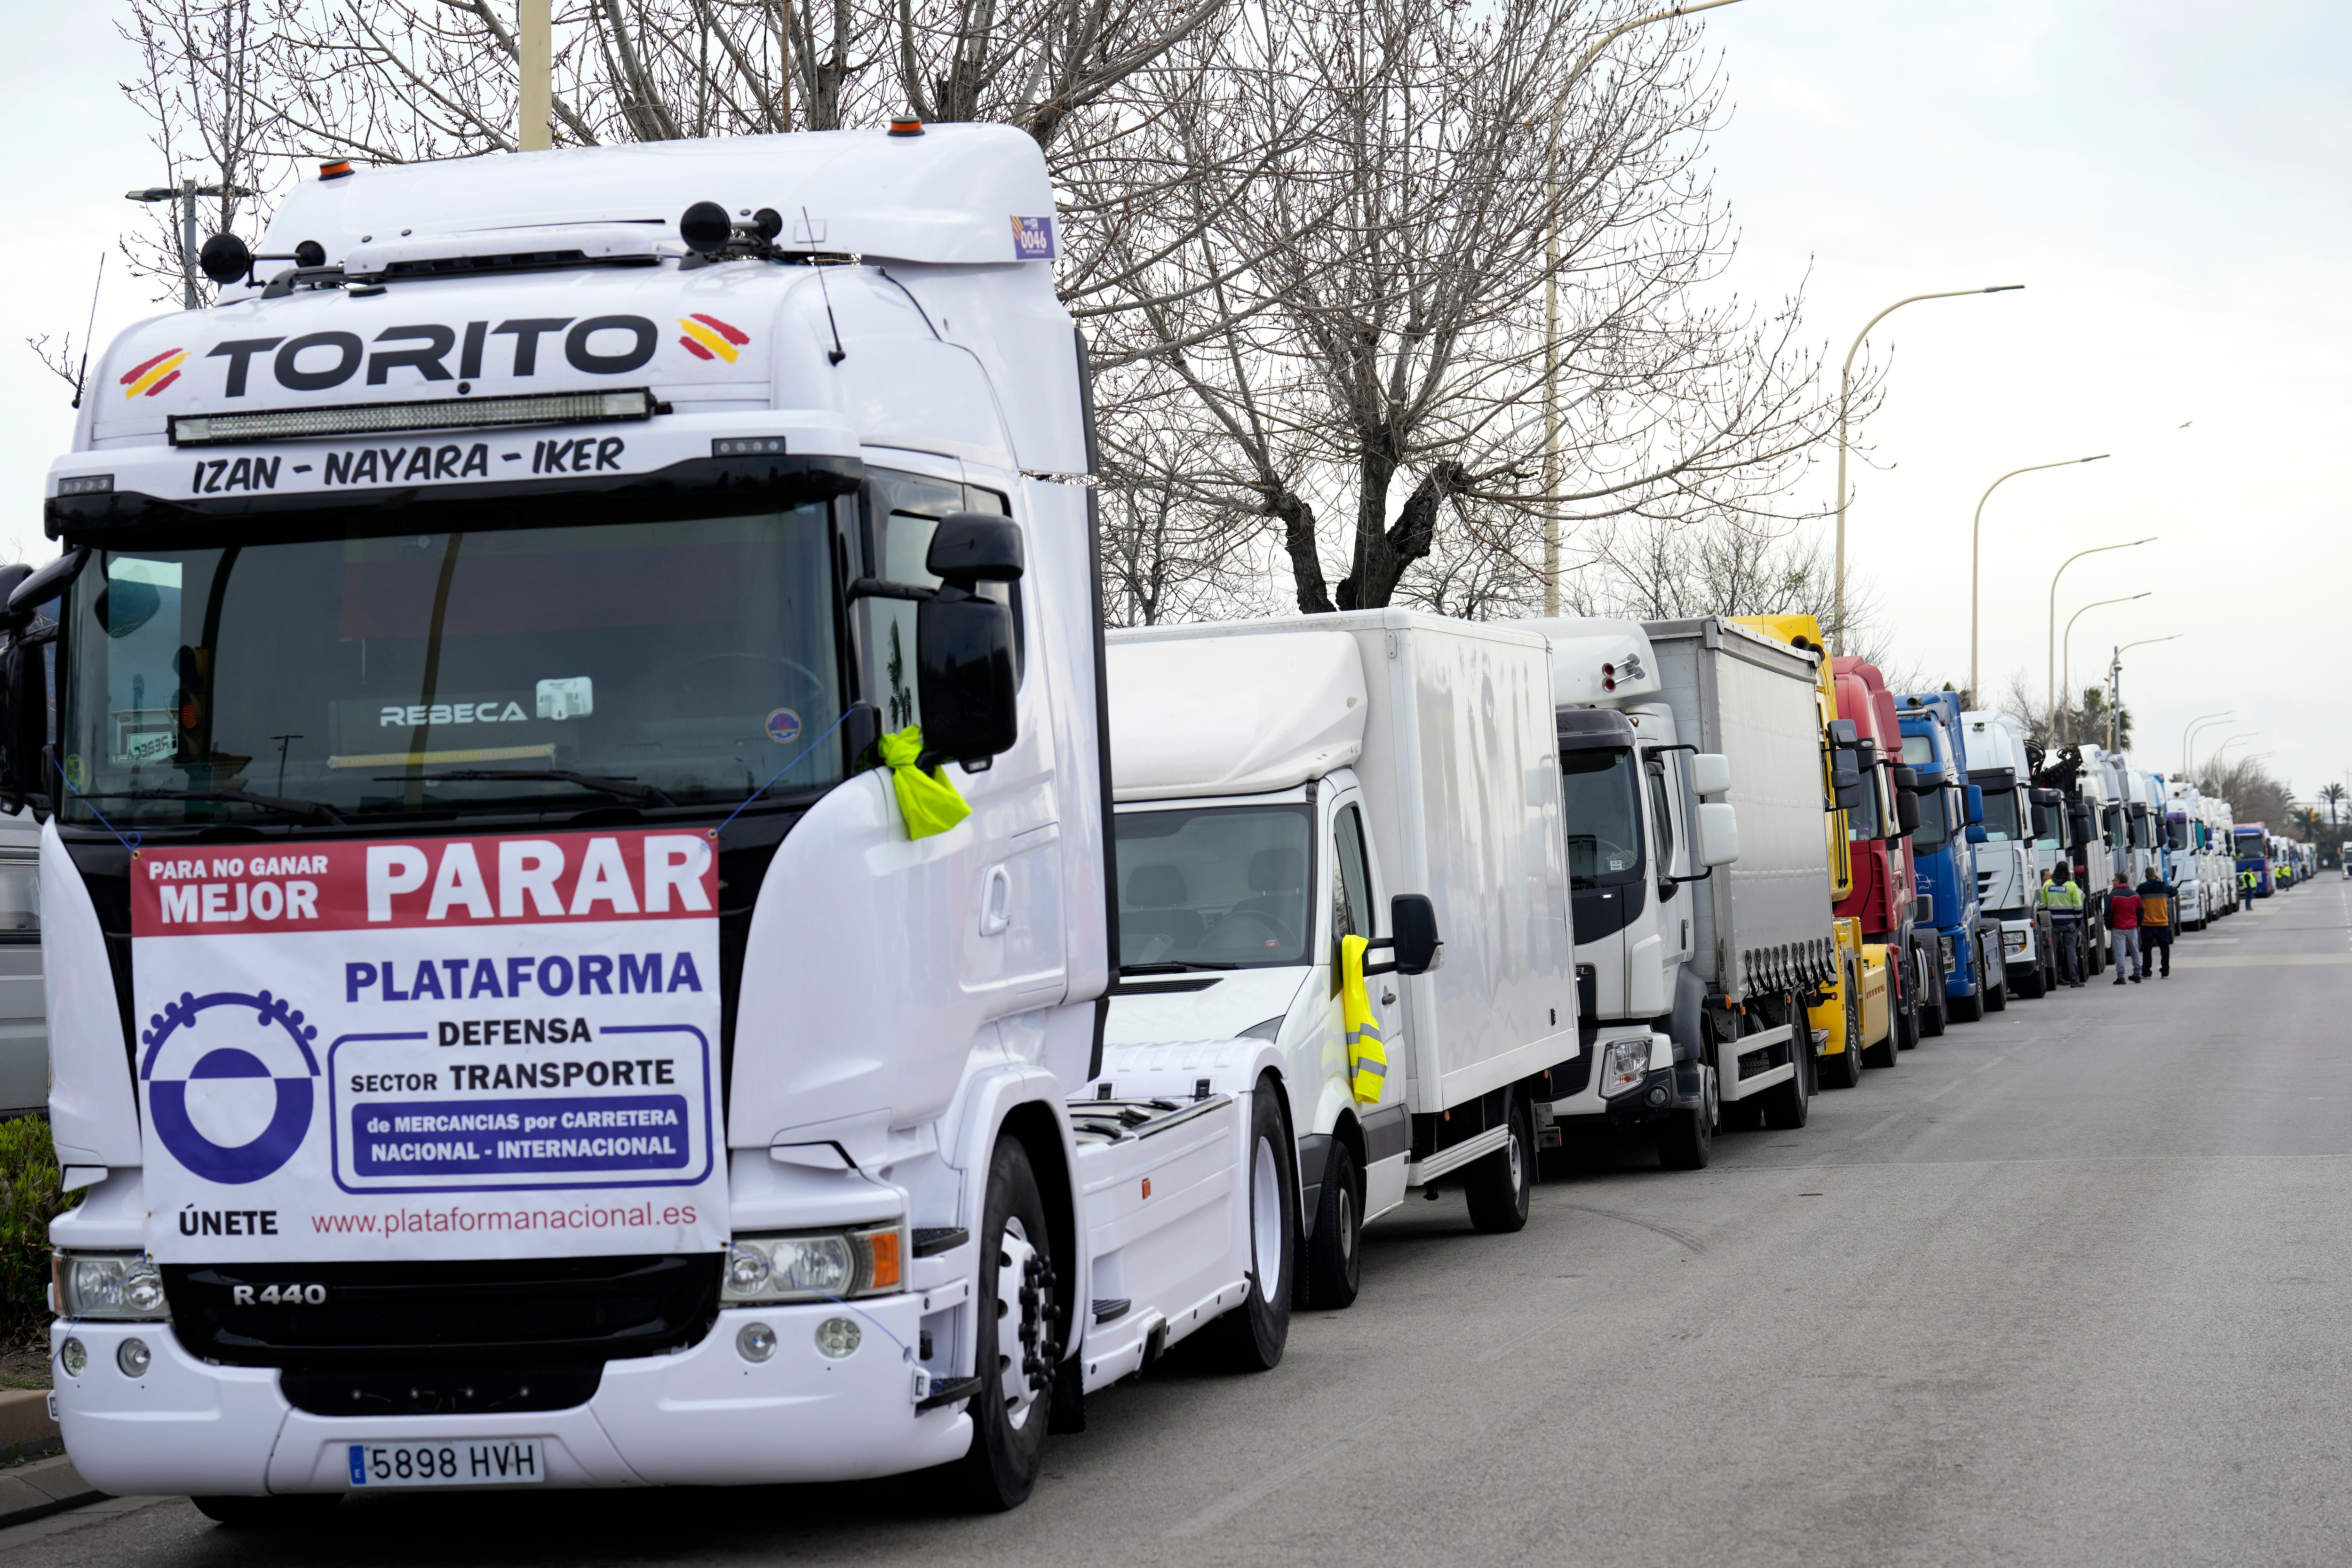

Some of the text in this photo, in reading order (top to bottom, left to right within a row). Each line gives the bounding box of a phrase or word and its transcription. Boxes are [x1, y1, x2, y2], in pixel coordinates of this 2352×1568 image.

[1020, 230, 1047, 249] 0046
[206, 315, 658, 398] TORITO
[193, 456, 281, 494] IZAN
[324, 443, 488, 486] NAYARA
[532, 437, 625, 474] IKER
[380, 701, 528, 726] REBECA
[149, 855, 328, 880] PARA NO GANAR
[366, 835, 713, 922] PARAR
[159, 880, 318, 923] MEJOR
[346, 952, 703, 1003] PLATAFORMA
[438, 1018, 592, 1047] DEFENSA
[351, 1059, 675, 1093] SECTOR TRANSPORTE
[367, 1109, 678, 1133] de MERCANCIAS por CARRETERA
[372, 1142, 480, 1162] NACIONAL
[497, 1136, 676, 1159] INTERNACIONAL
[180, 1203, 278, 1236] ÚNETE
[311, 1202, 697, 1239] www.plataformanacional.es
[233, 1284, 326, 1305] R 440
[373, 1444, 534, 1480] 5898 HVH
